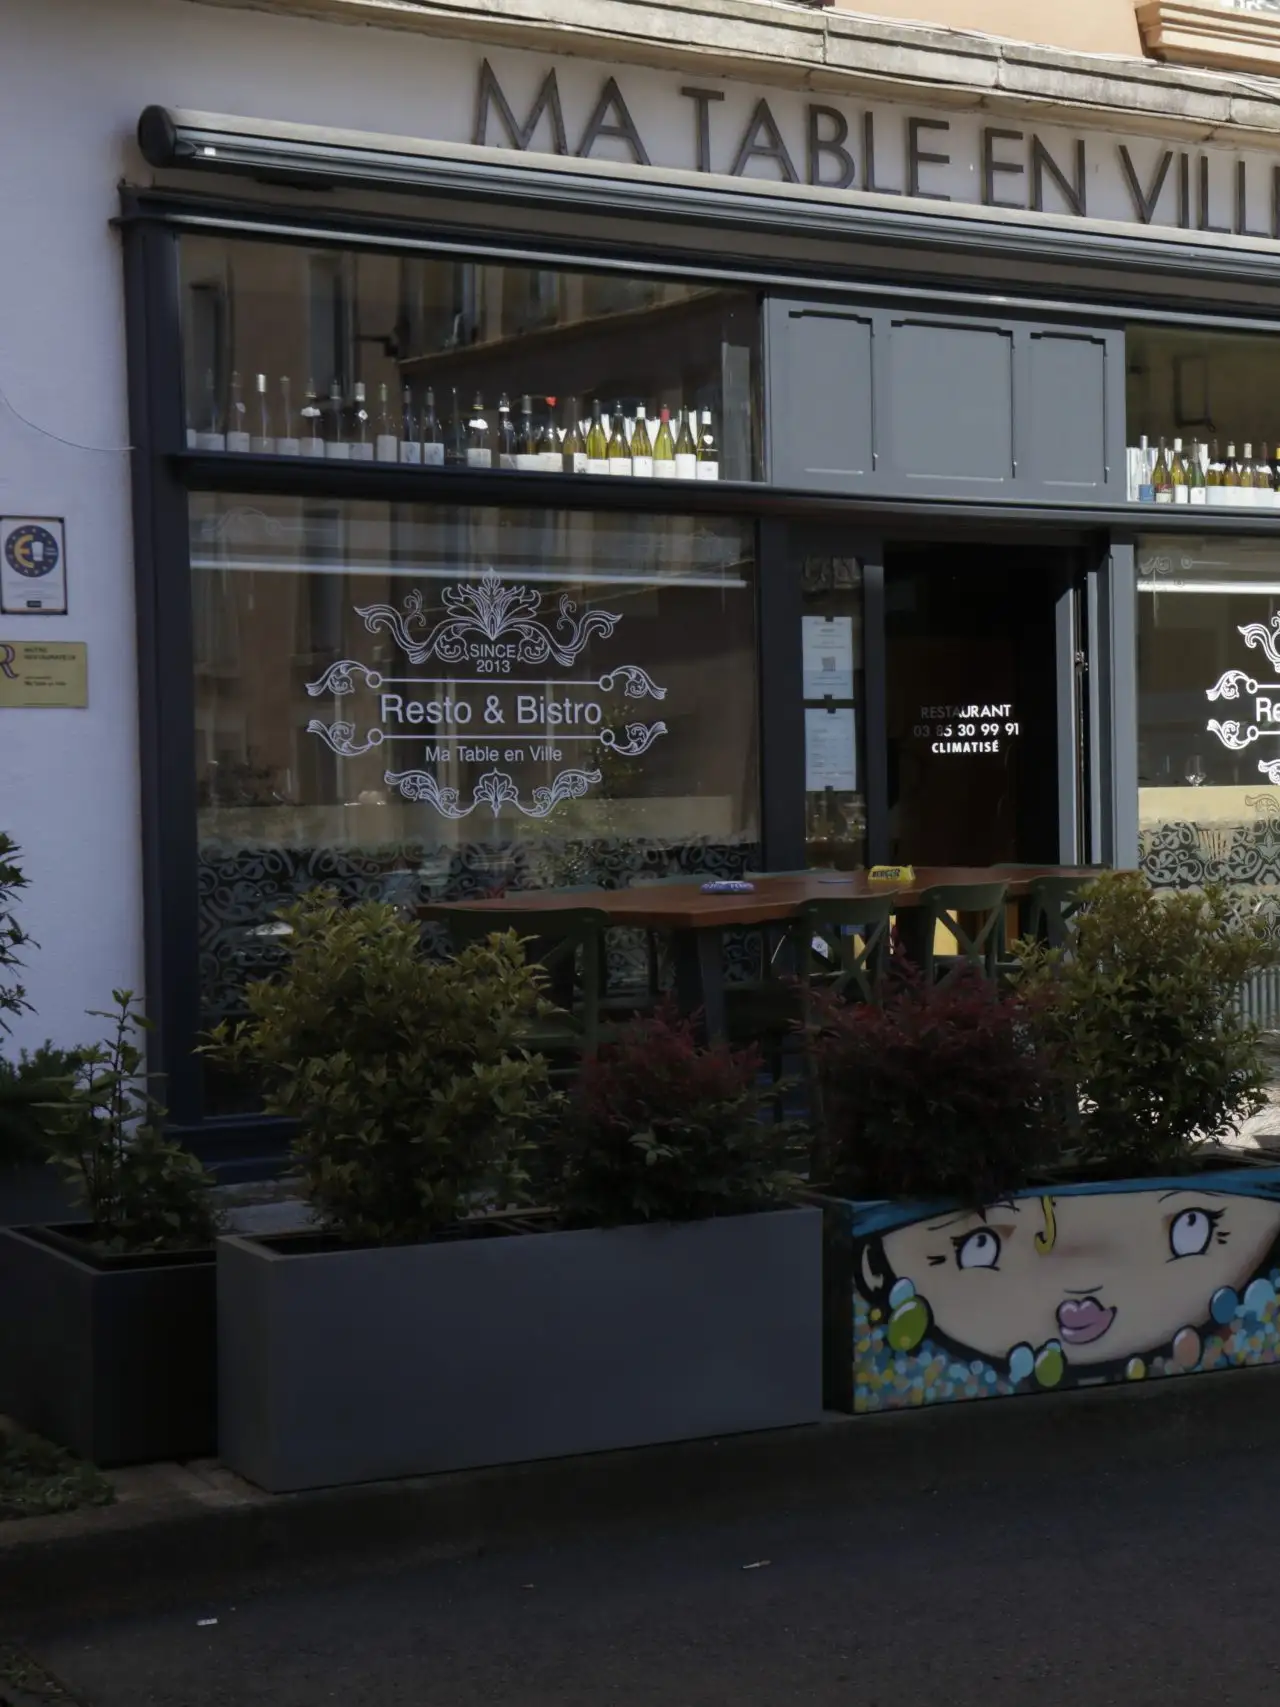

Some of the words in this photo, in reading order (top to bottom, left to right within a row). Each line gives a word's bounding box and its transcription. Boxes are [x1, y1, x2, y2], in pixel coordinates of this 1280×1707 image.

[473, 57, 651, 167] MA
[681, 86, 952, 201] TABLE
[983, 126, 1087, 217] EN
[470, 644, 516, 659] SINCE
[476, 659, 511, 674] 2013
[380, 694, 472, 724] Resto
[483, 695, 505, 724] &
[517, 695, 602, 725] Bistro
[921, 704, 1011, 719] RESTAURANT
[957, 723, 975, 737] 30
[980, 723, 999, 736] 99
[1005, 722, 1019, 736] 91
[425, 745, 451, 762] Ma
[456, 745, 499, 762] Table
[504, 749, 524, 762] en
[530, 745, 562, 762] Ville
[931, 740, 999, 753] CLIMATISÉ
